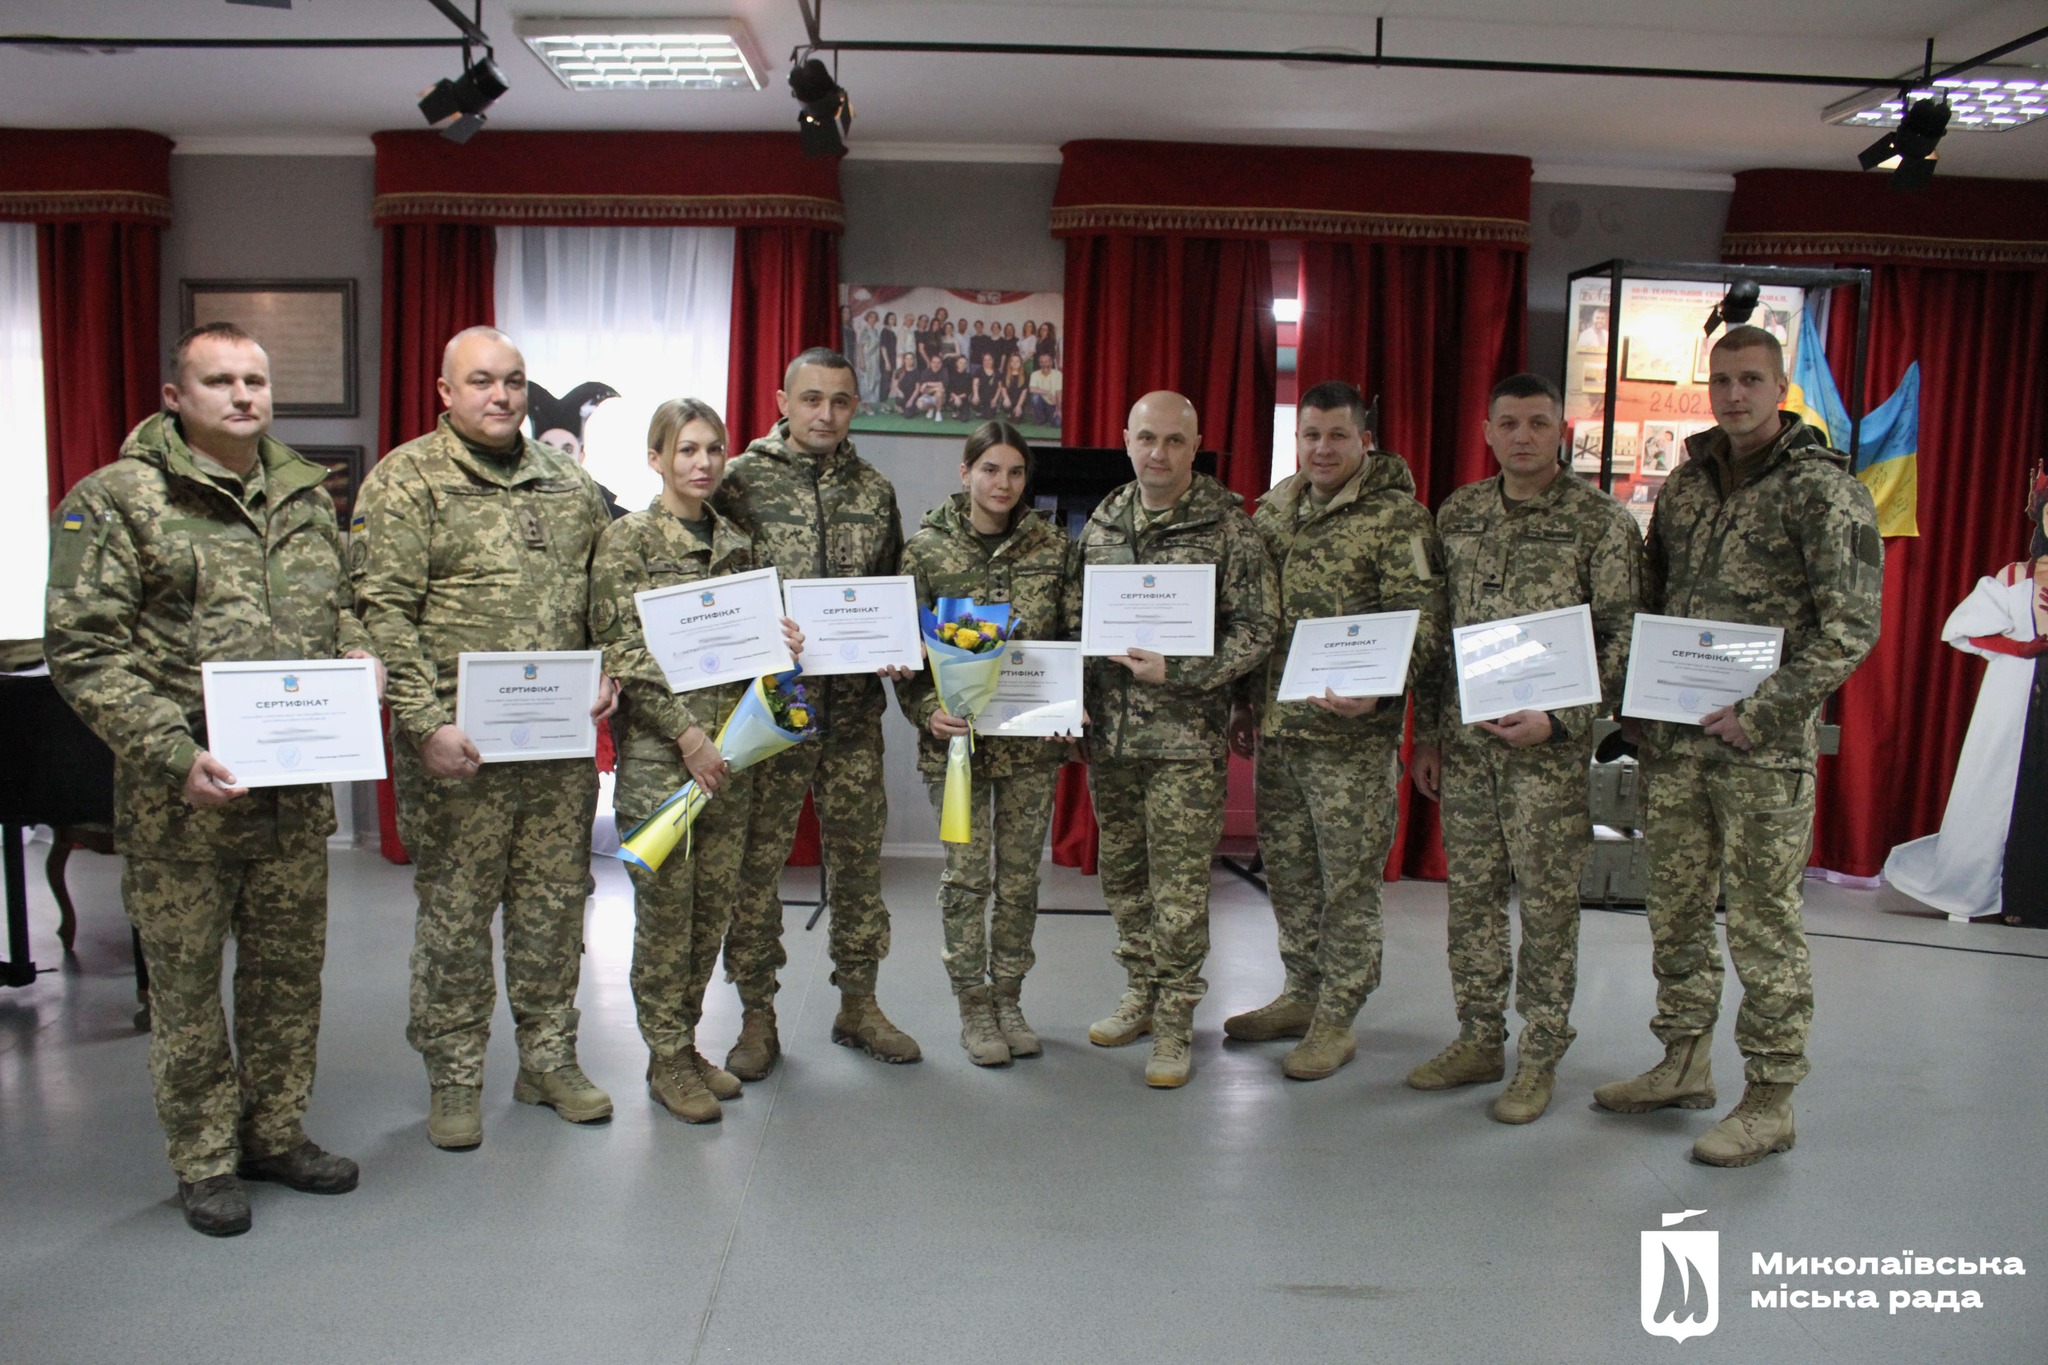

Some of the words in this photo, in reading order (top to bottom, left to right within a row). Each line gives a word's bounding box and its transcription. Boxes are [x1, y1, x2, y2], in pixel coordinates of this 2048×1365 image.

[1650, 391, 1714, 414] 24.02.
[823, 606, 879, 615] СЕРТИФІКАТ
[680, 607, 741, 625] СЕРТИФІКАТ
[1324, 640, 1377, 648] СЕРТИФІКАТ
[1672, 650, 1737, 663] СЕРТИФІКАТ
[499, 686, 560, 694] СЕРТИФІКАТ
[255, 699, 329, 709] СЕРТИФІКАТ
